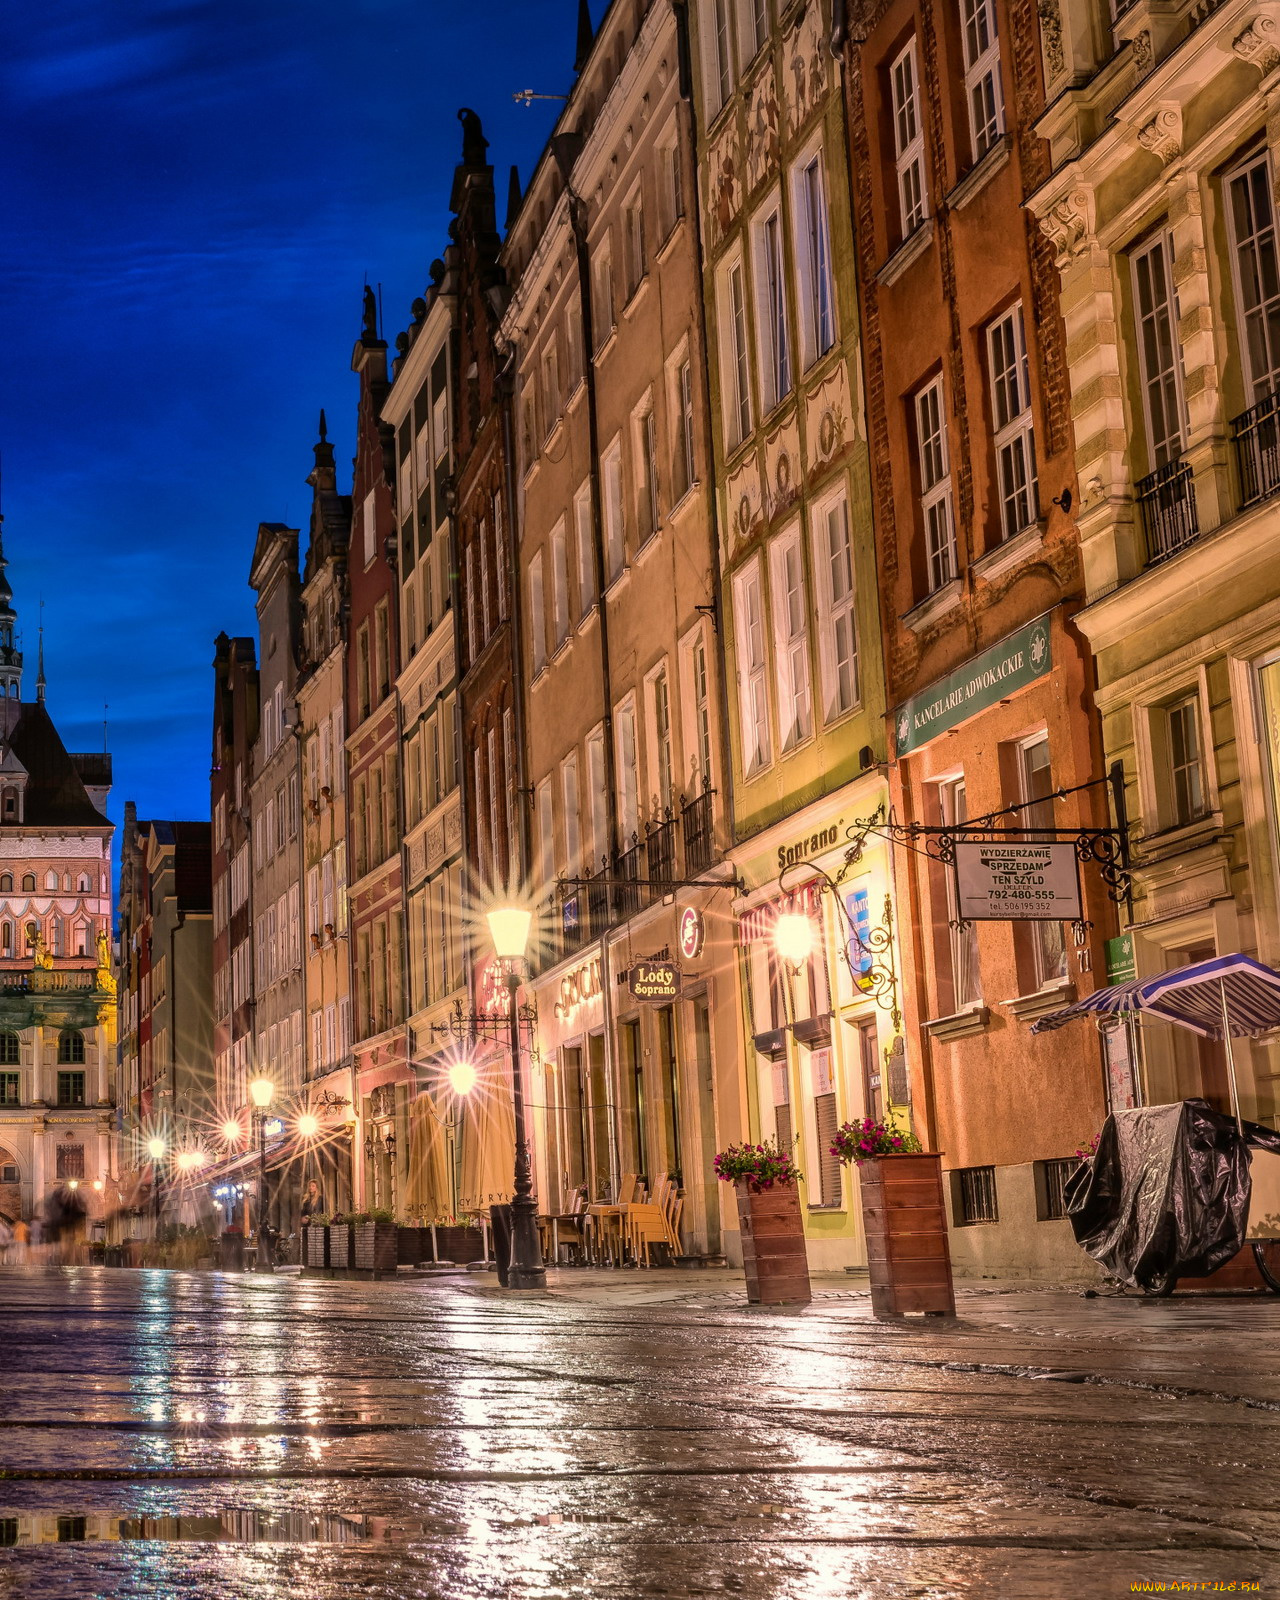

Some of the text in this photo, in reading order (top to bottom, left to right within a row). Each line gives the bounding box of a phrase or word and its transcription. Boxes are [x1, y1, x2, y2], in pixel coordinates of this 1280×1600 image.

[913, 686, 964, 730] KANCELARIE
[965, 651, 1025, 701] ADWOKACKIE
[777, 824, 838, 869] Soprano
[980, 847, 1051, 860] WYDZIERŻAWIĘ
[990, 862, 1044, 871] SPRZEDAM
[992, 875, 1044, 885] TEN SZYLD
[987, 890, 1055, 900] 792-480-555
[1004, 902, 1019, 910] 506
[1021, 902, 1034, 910] 195
[1035, 902, 1051, 910] 352
[638, 967, 673, 985] Lody
[634, 983, 676, 997] Soprano
